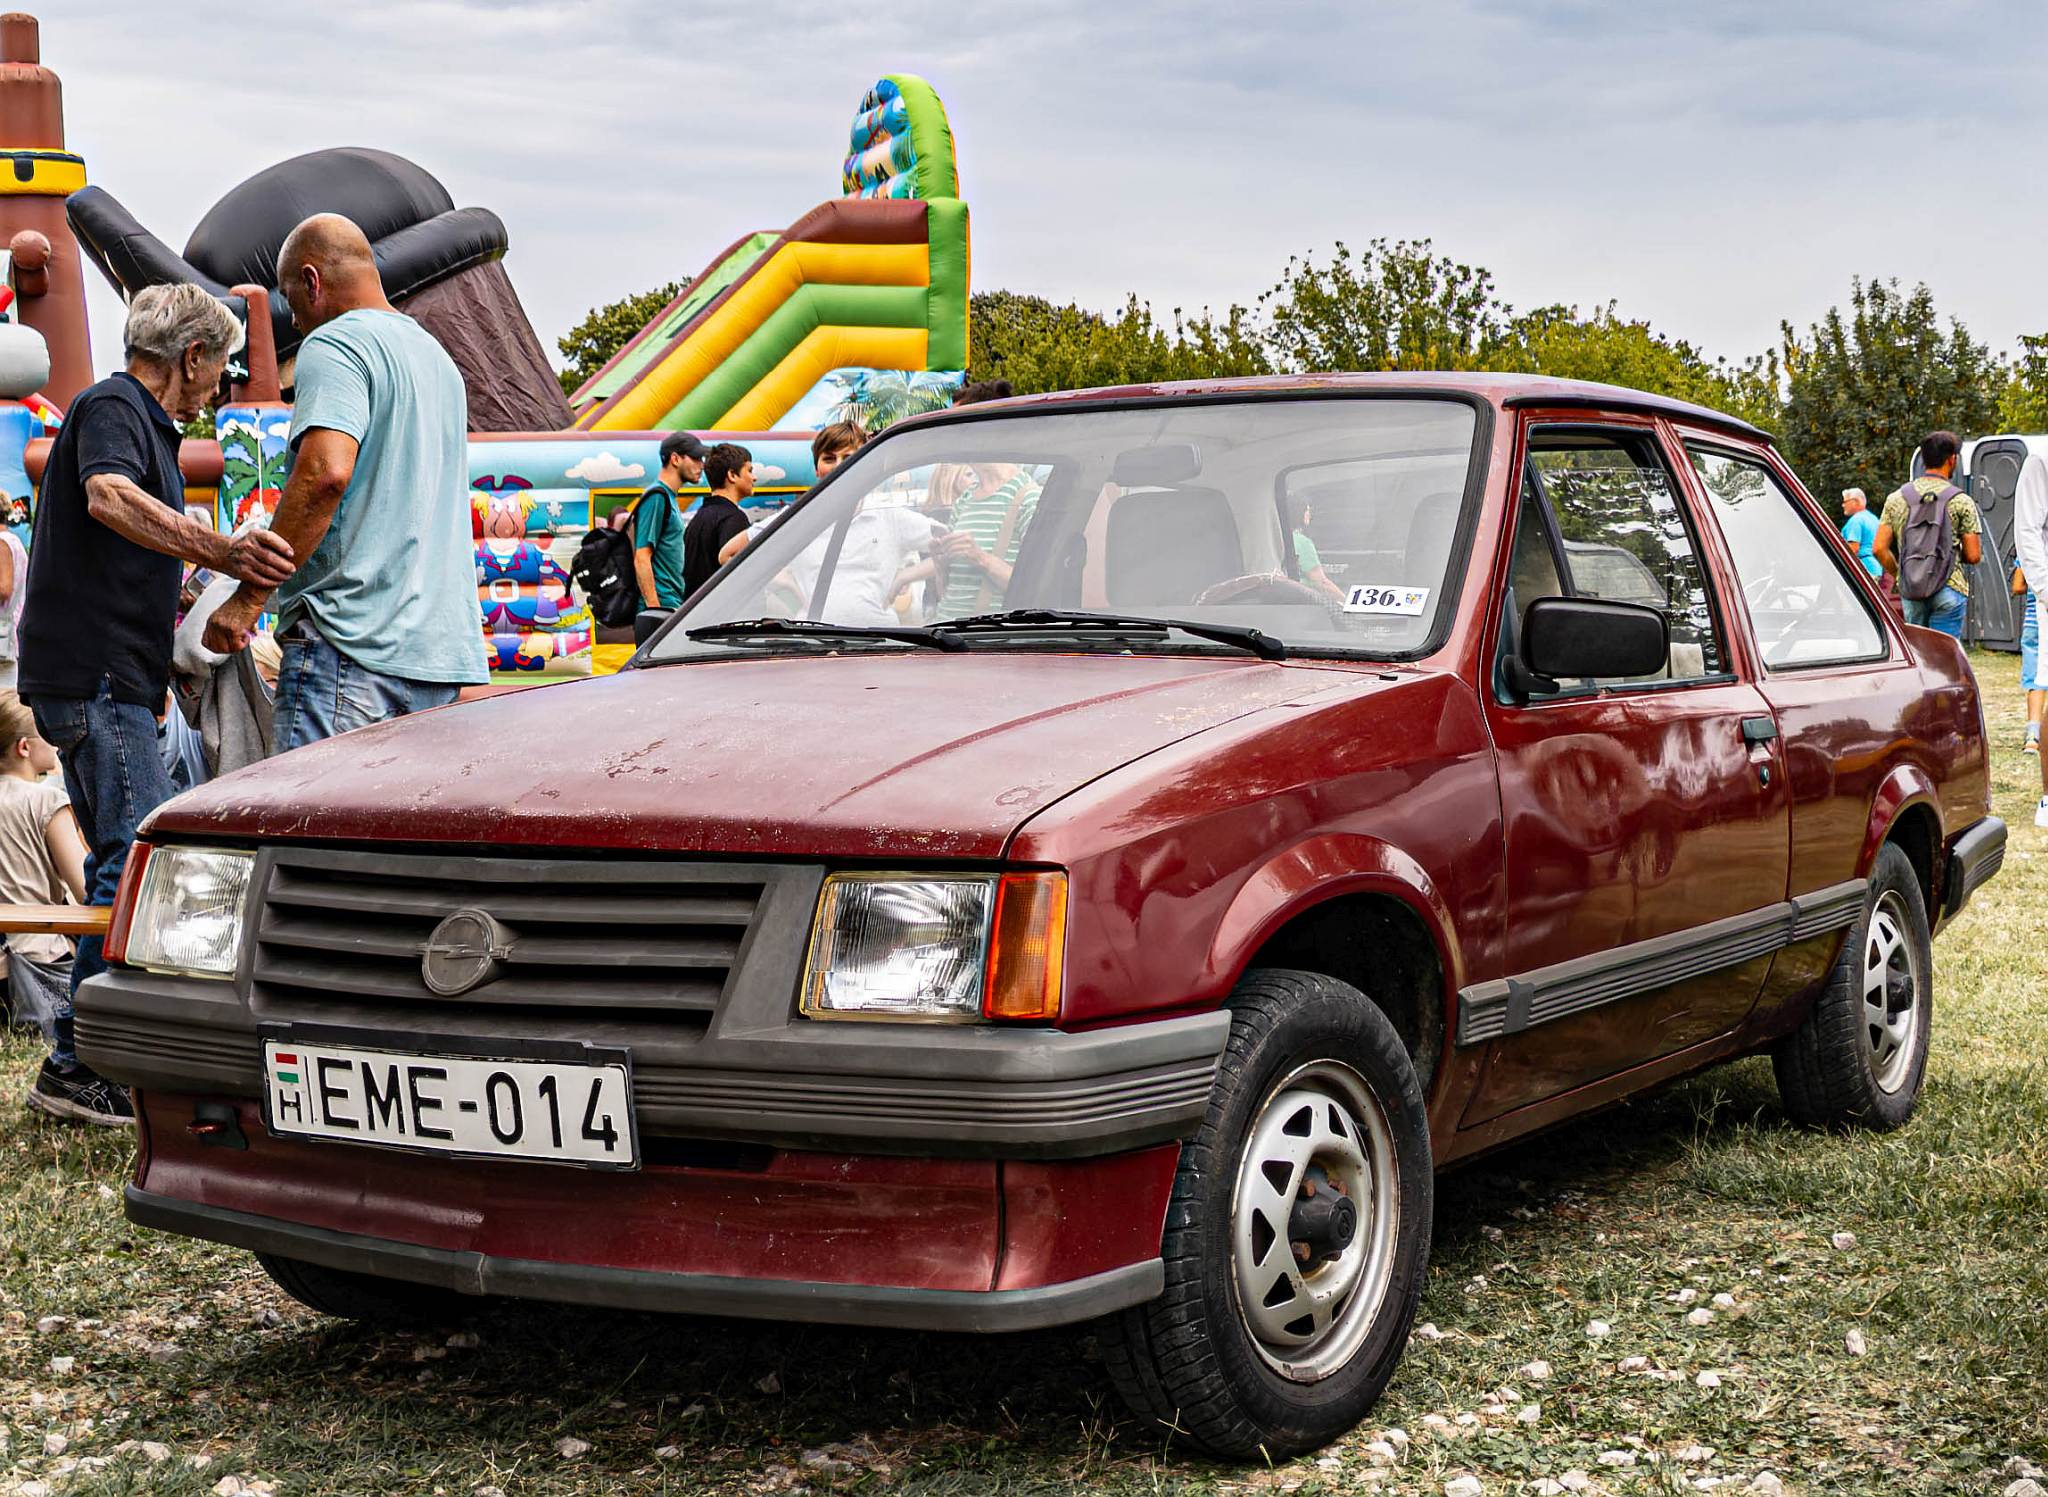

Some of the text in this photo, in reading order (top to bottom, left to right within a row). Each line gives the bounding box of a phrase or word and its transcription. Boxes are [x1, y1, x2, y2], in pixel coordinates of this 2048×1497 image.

[1350, 588, 1401, 606] 136.
[279, 1089, 301, 1123] H
[316, 1056, 618, 1151] EME-014
